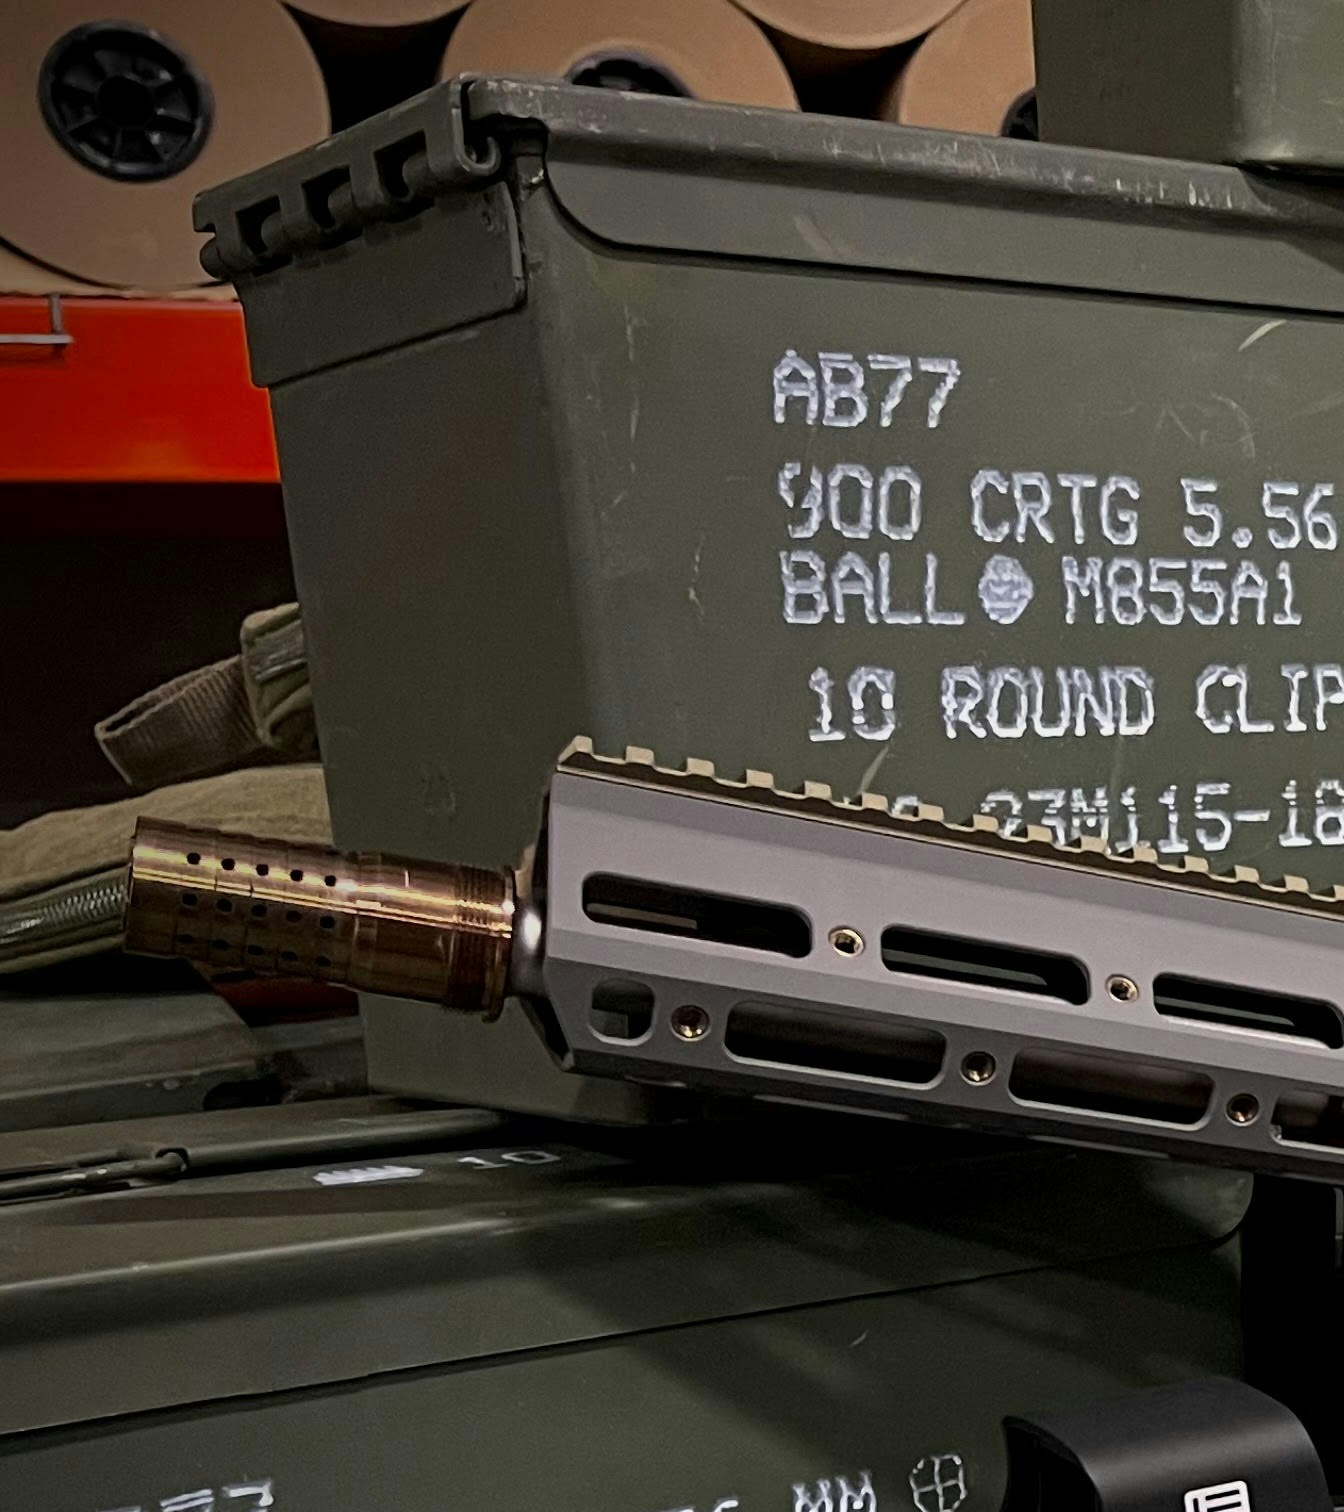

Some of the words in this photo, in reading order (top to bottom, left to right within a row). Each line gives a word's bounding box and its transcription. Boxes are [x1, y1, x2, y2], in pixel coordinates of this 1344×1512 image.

[772, 351, 960, 428] AB77
[778, 462, 922, 541] 900
[970, 470, 1140, 547] CRTG
[1182, 477, 1339, 551] 5.56
[780, 550, 965, 624] BALL
[1063, 558, 1302, 626] M855A1
[808, 665, 895, 742] 10
[942, 664, 1154, 740] ROUND
[455, 1147, 561, 1171] 10
